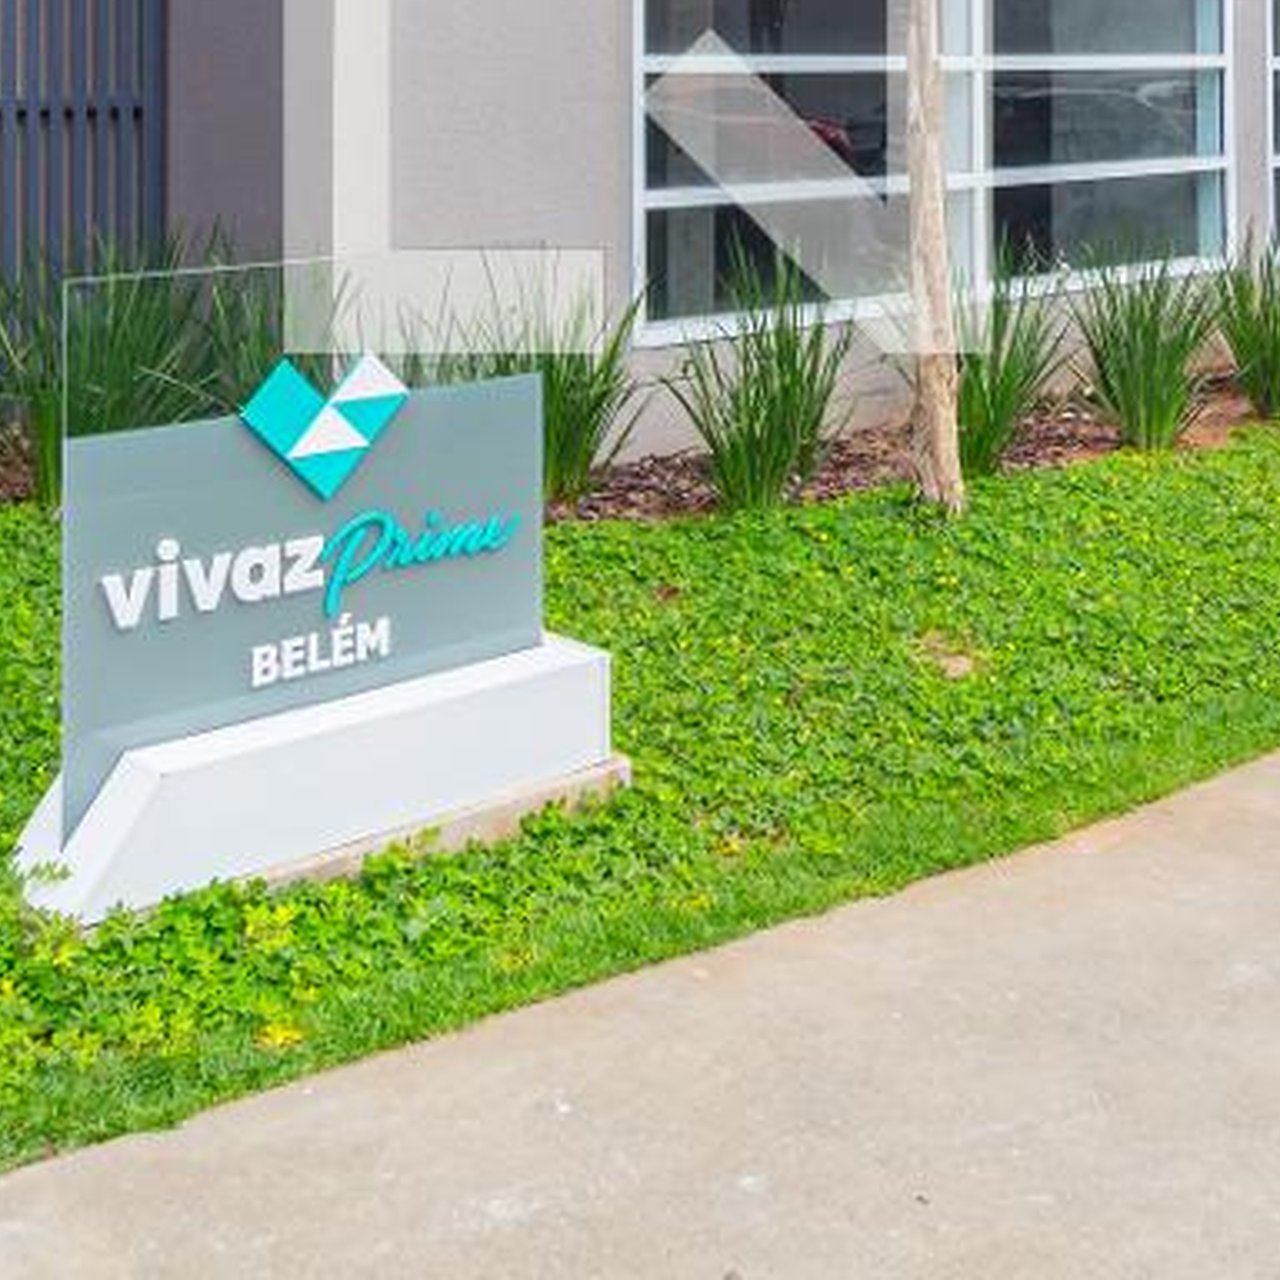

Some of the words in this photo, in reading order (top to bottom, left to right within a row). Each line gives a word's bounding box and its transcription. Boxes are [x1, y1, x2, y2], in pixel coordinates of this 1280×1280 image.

[101, 538, 324, 629] vivaz
[322, 510, 521, 617] Prime
[251, 612, 390, 687] BELÉM
